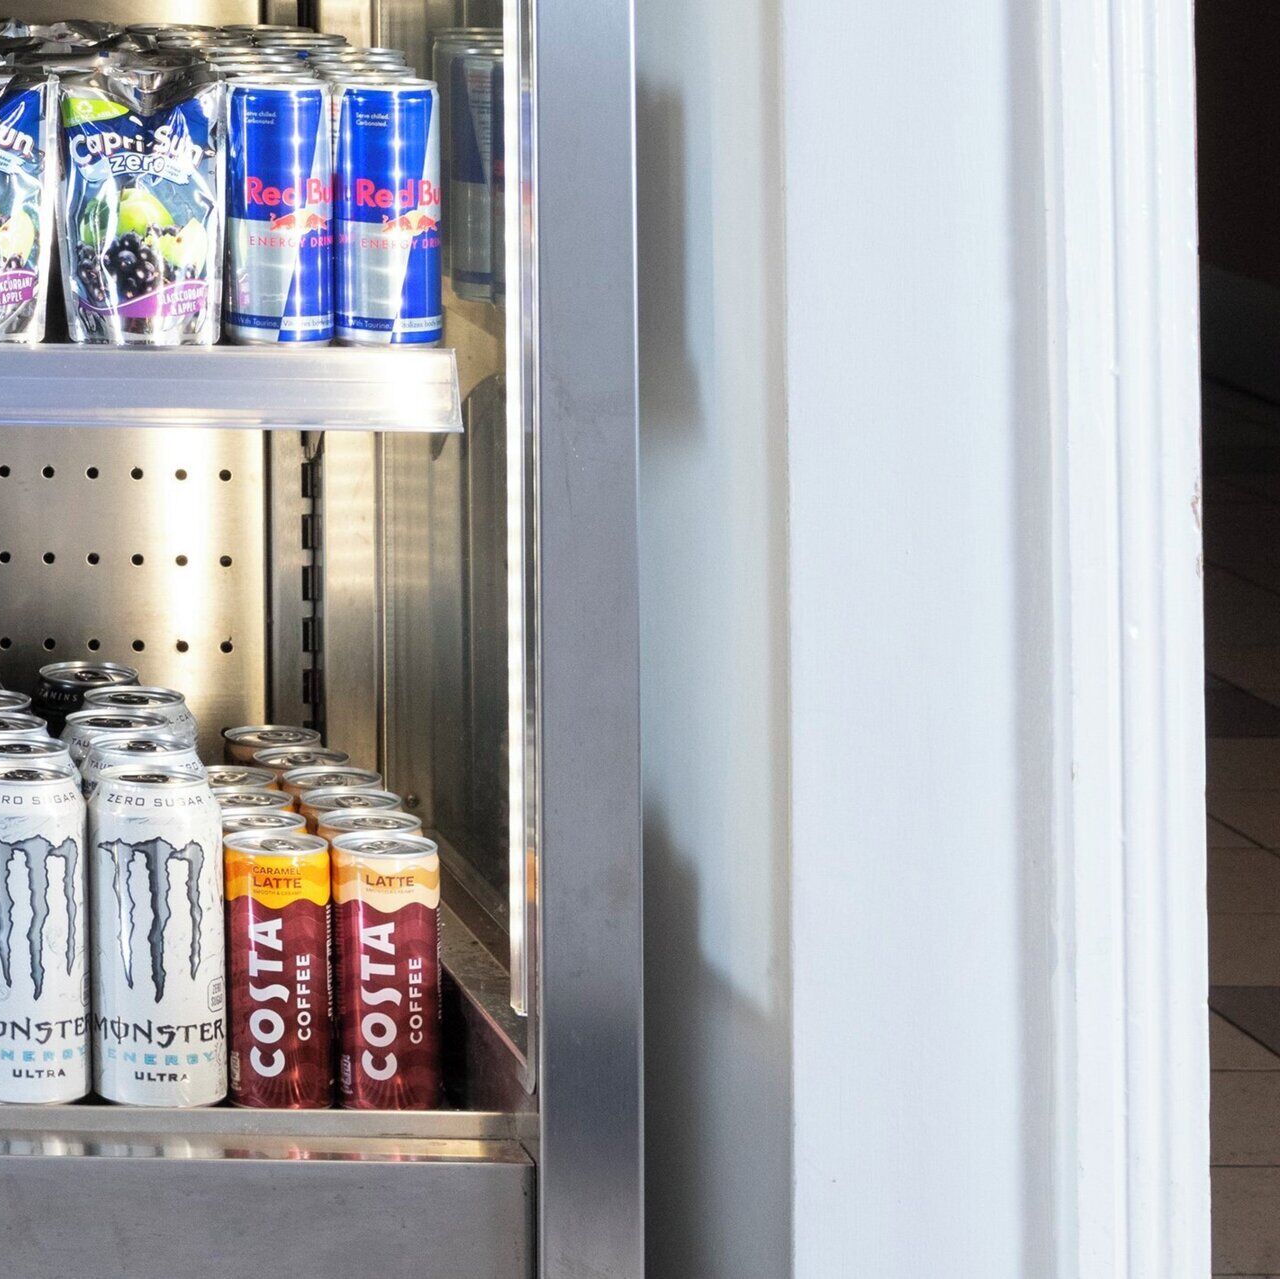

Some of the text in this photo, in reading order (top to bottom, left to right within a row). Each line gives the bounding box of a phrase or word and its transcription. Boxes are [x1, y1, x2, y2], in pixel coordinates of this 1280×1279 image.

[356, 178, 413, 207] Red
[107, 796, 204, 806] ZERO SUGAR
[253, 867, 301, 875] CARAMEL
[366, 875, 414, 887] LATTE
[253, 877, 302, 889] LATTE
[248, 918, 290, 1077] COSTA
[296, 954, 311, 1041] COFFEE
[360, 922, 403, 1080] COSTA
[408, 958, 423, 1044] COFFEE
[94, 1016, 225, 1048] MONSTER
[12, 1068, 65, 1078] ULTRA
[135, 1072, 188, 1081] ULTRA
